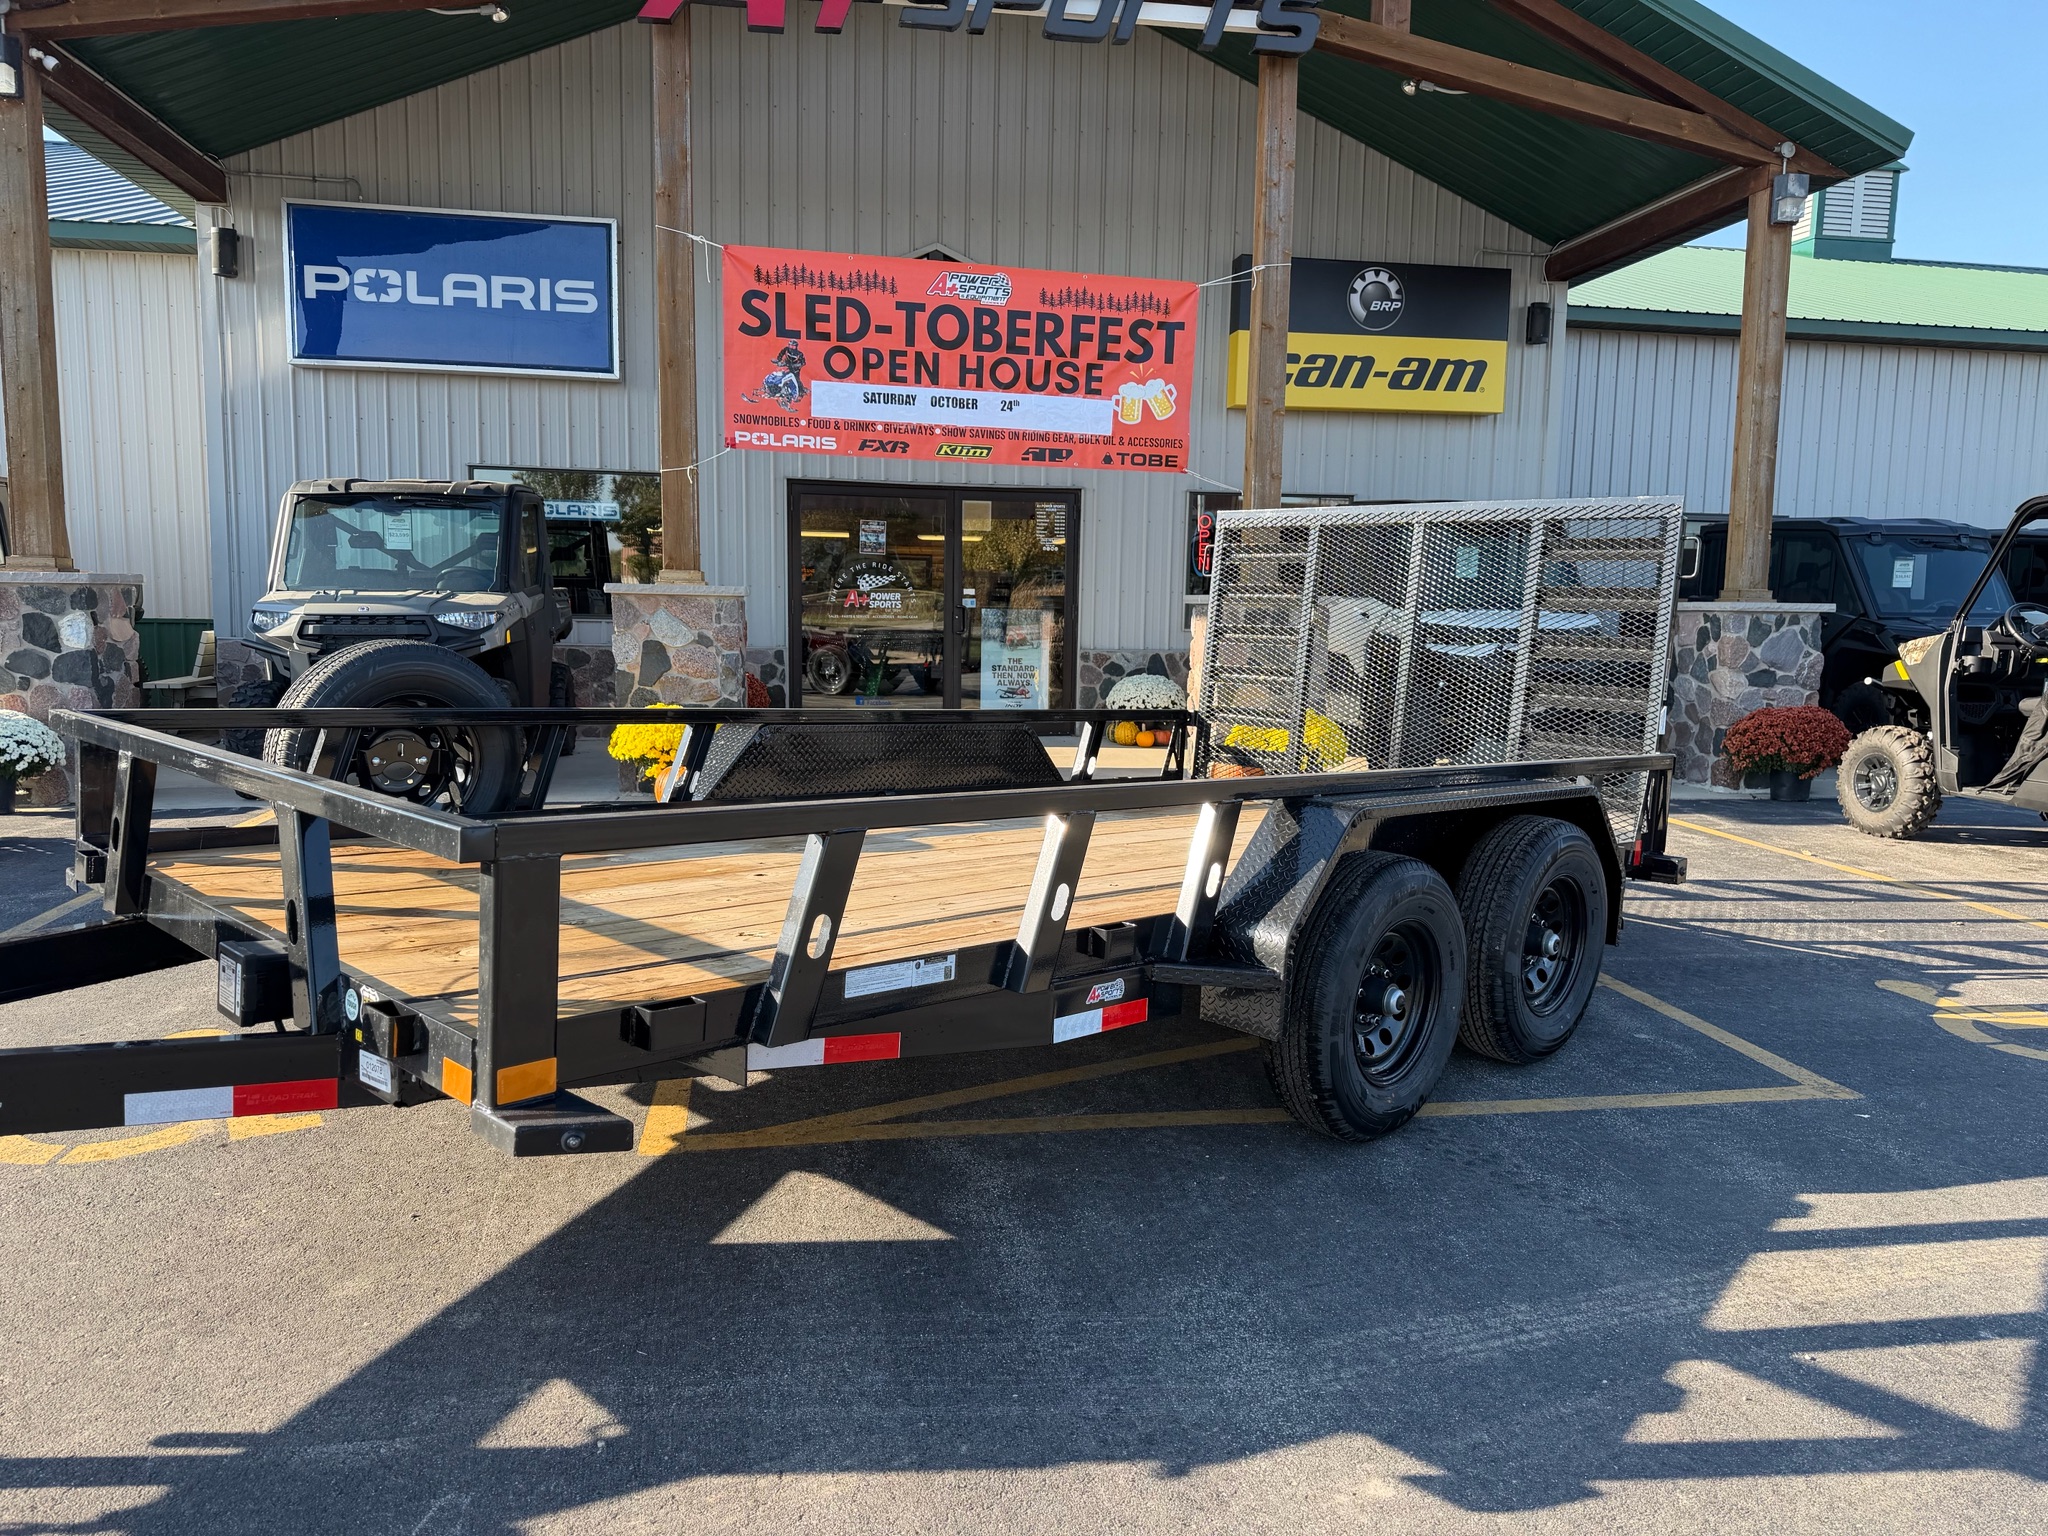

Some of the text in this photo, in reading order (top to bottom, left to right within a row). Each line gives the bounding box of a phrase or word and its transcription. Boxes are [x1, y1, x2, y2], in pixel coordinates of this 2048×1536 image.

[303, 264, 599, 314] POLARIS
[1370, 300, 1401, 312] BRP
[738, 289, 1185, 364] SLED-TOBERFEST
[823, 345, 1104, 395] OPEN HOUSE
[863, 391, 1020, 412] SATURDAY OCTOBER 24th
[733, 413, 1184, 449] SNOWMOBILES FOOD & DRINKS GIVEAWAYS SHOW SAVINGS ON RIDING GEAR, BULK OIL & ACCESSORIES
[734, 431, 838, 450] POLARIS
[857, 438, 911, 454] FXR
[1116, 452, 1179, 468] TOBE
[544, 503, 618, 517] OLARIS
[1197, 514, 1212, 571] OPEN
[830, 572, 848, 602] WHERE
[849, 562, 867, 573] THE
[872, 561, 894, 572] RIDE
[896, 571, 917, 604] STARTS
[506, 601, 518, 611] XP
[844, 589, 901, 608] A+ POWER
[869, 600, 902, 609] SPORTS
[1007, 657, 1023, 665] THE
[261, 1092, 290, 1103] LOAD
